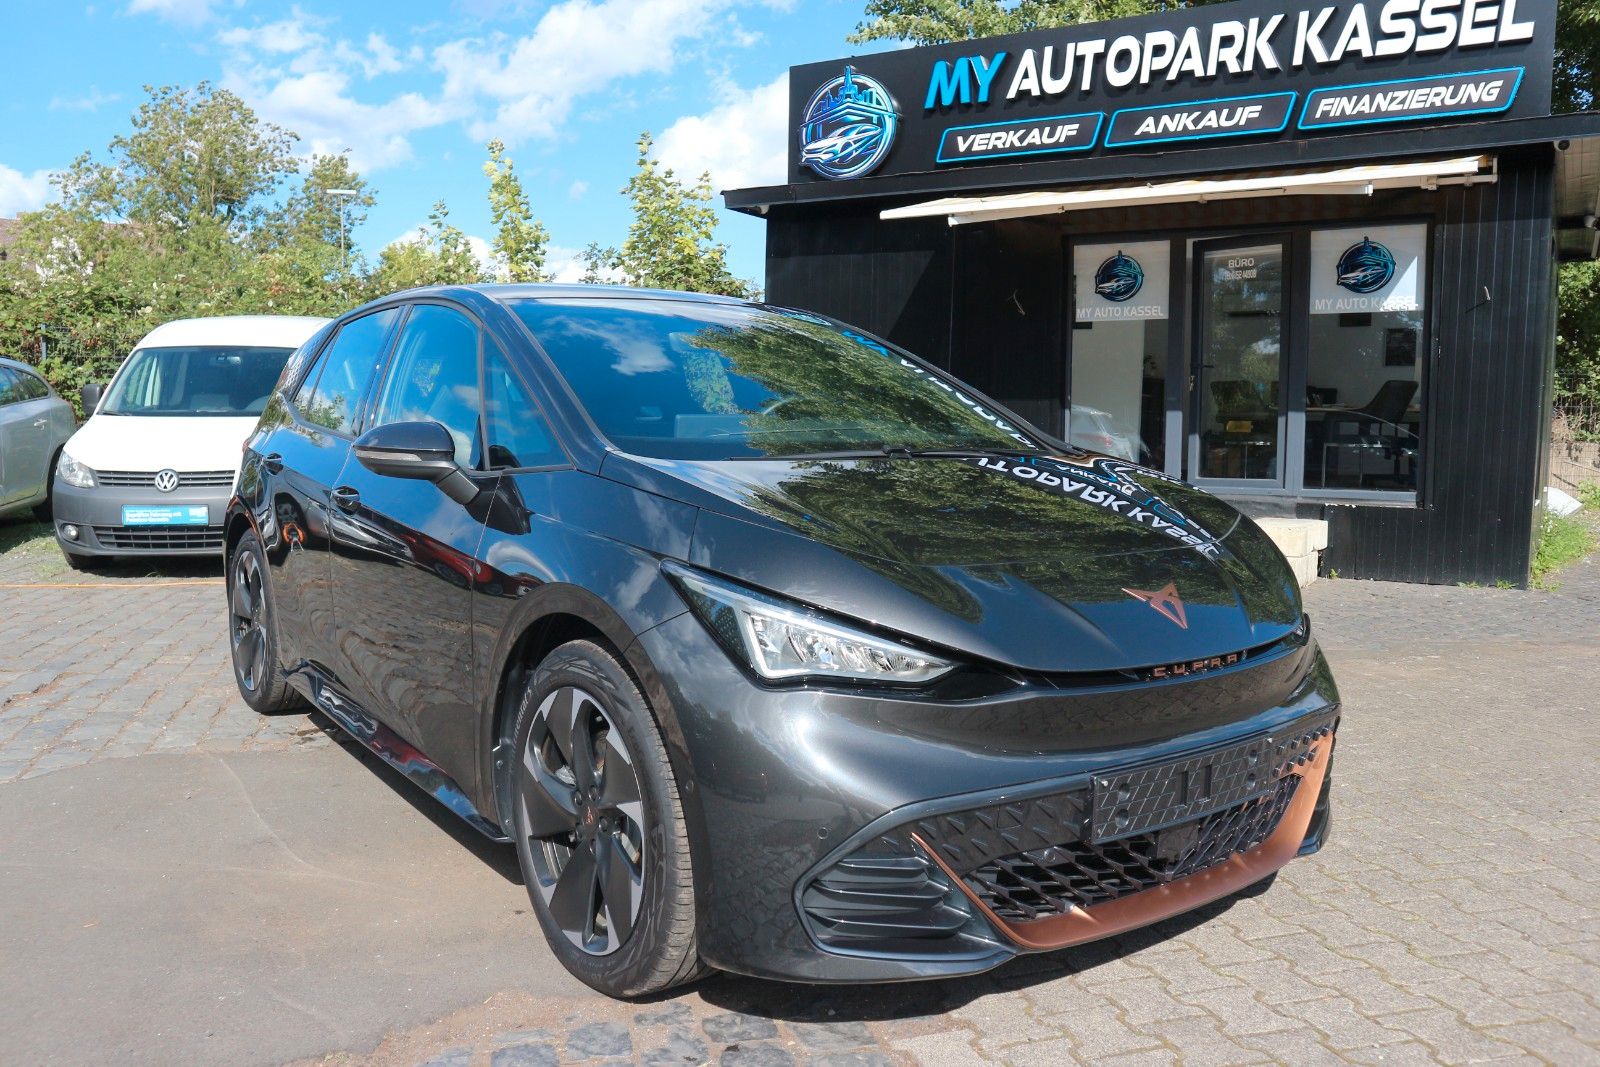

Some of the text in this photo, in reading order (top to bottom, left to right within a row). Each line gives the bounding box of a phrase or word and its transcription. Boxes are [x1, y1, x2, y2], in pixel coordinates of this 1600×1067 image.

[924, 0, 1535, 109] MY AUTOPARK KASSEL
[1314, 79, 1504, 119] FINANZIERUNG
[1134, 105, 1263, 136] ANKAUF
[956, 123, 1080, 153] VERKAUF
[1228, 257, 1255, 268] BÜRO
[1076, 305, 1164, 319] MY AUTO KASSEL
[1315, 299, 1331, 310] MY
[1335, 297, 1368, 309] AUTO
[1153, 654, 1238, 677] CUPRA
